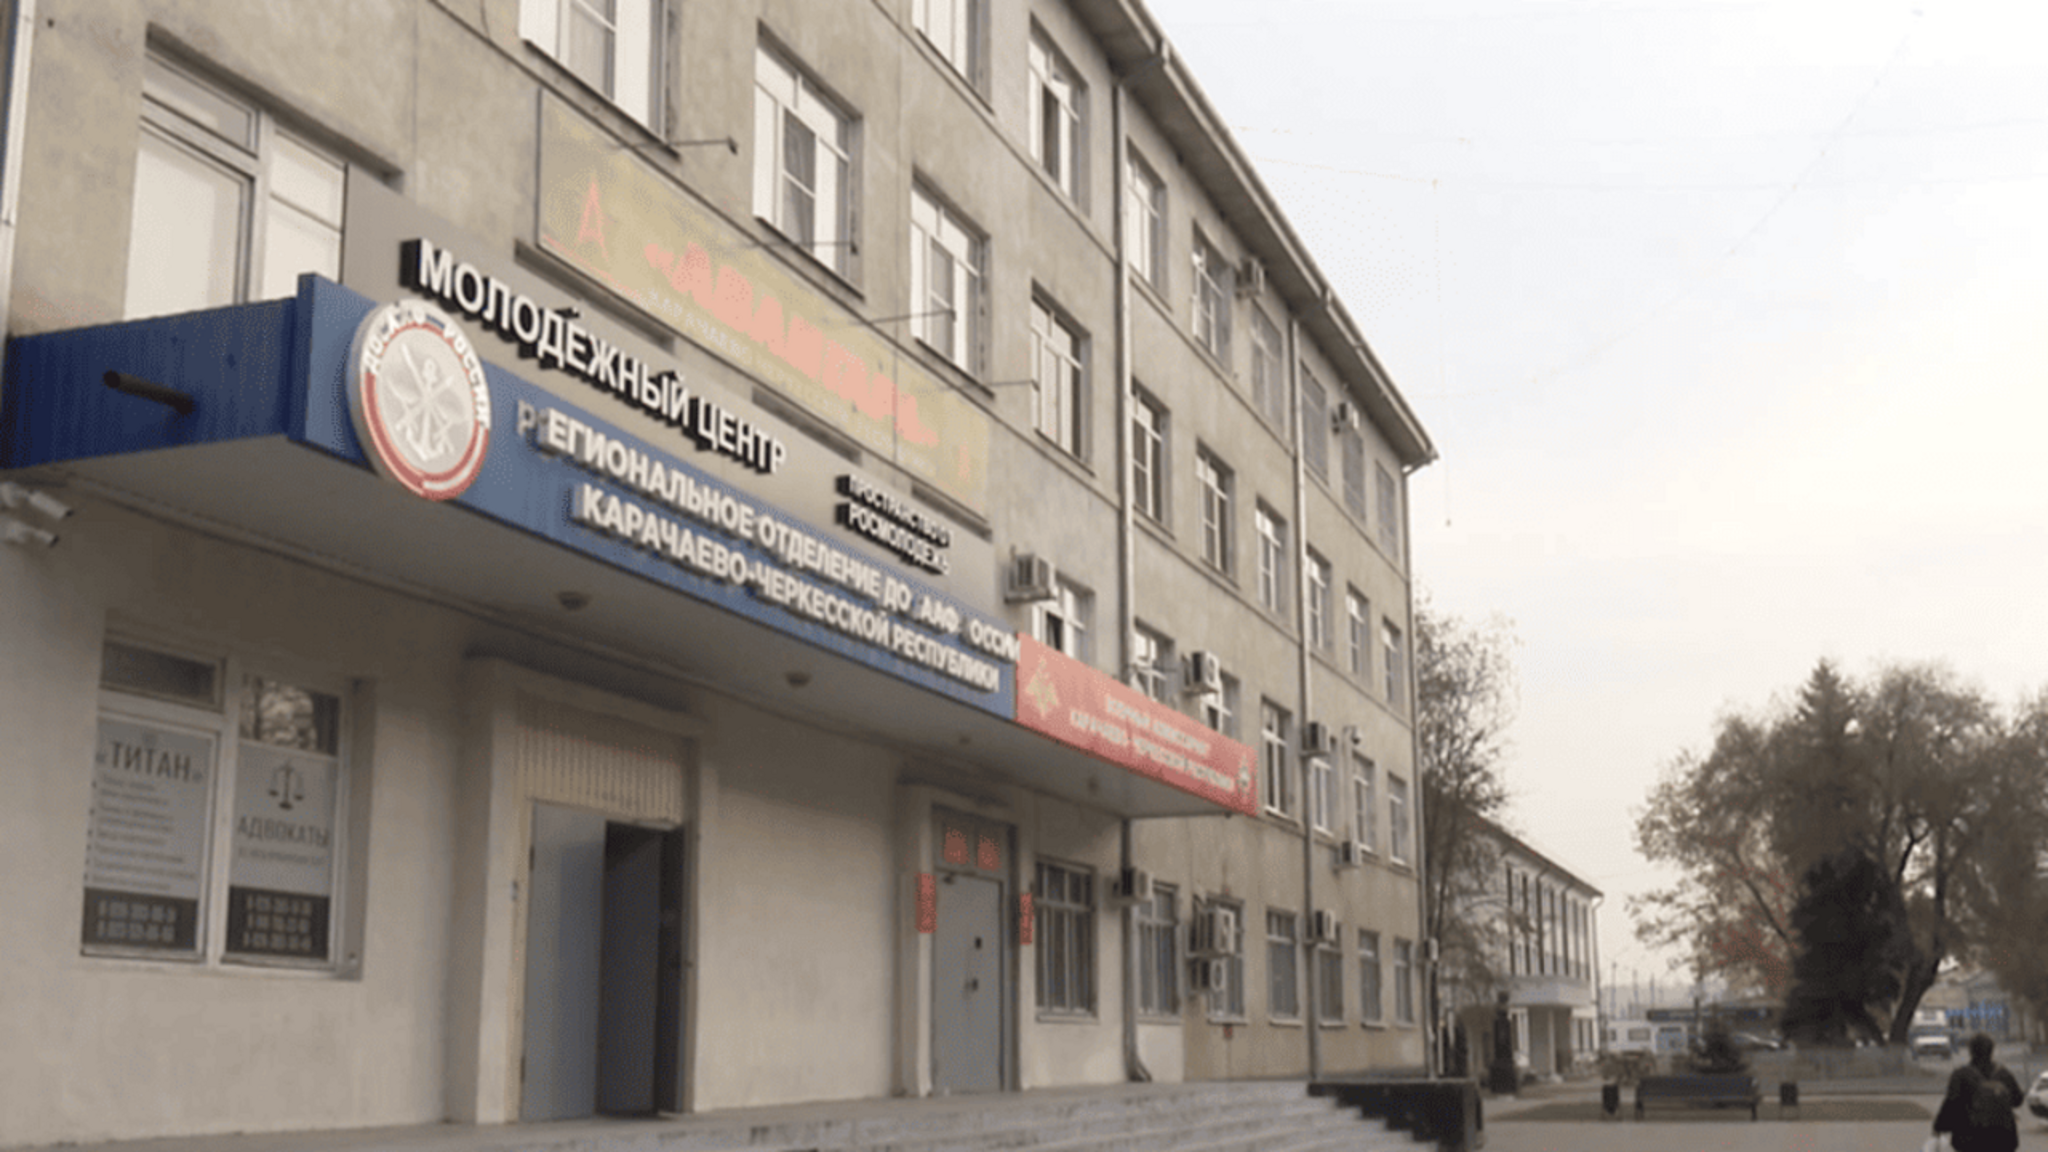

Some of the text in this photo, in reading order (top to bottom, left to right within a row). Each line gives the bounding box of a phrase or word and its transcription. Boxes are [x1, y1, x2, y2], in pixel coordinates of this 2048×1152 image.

[418, 237, 691, 428] МОЛОДЁЖНЫЙ
[697, 396, 788, 475] ЦЕНТР
[517, 399, 756, 539] РЕГИОНАЛЬНОЕ
[759, 514, 881, 599] ОТДЕЛЕНИЕ
[883, 576, 960, 634] ДОААФ
[582, 482, 1000, 692] КАРАЧАЕВО-ЧЕРКЕССКОЙ РЕСПУБЛИКИ
[237, 815, 330, 847] АДВОКАТЫ
